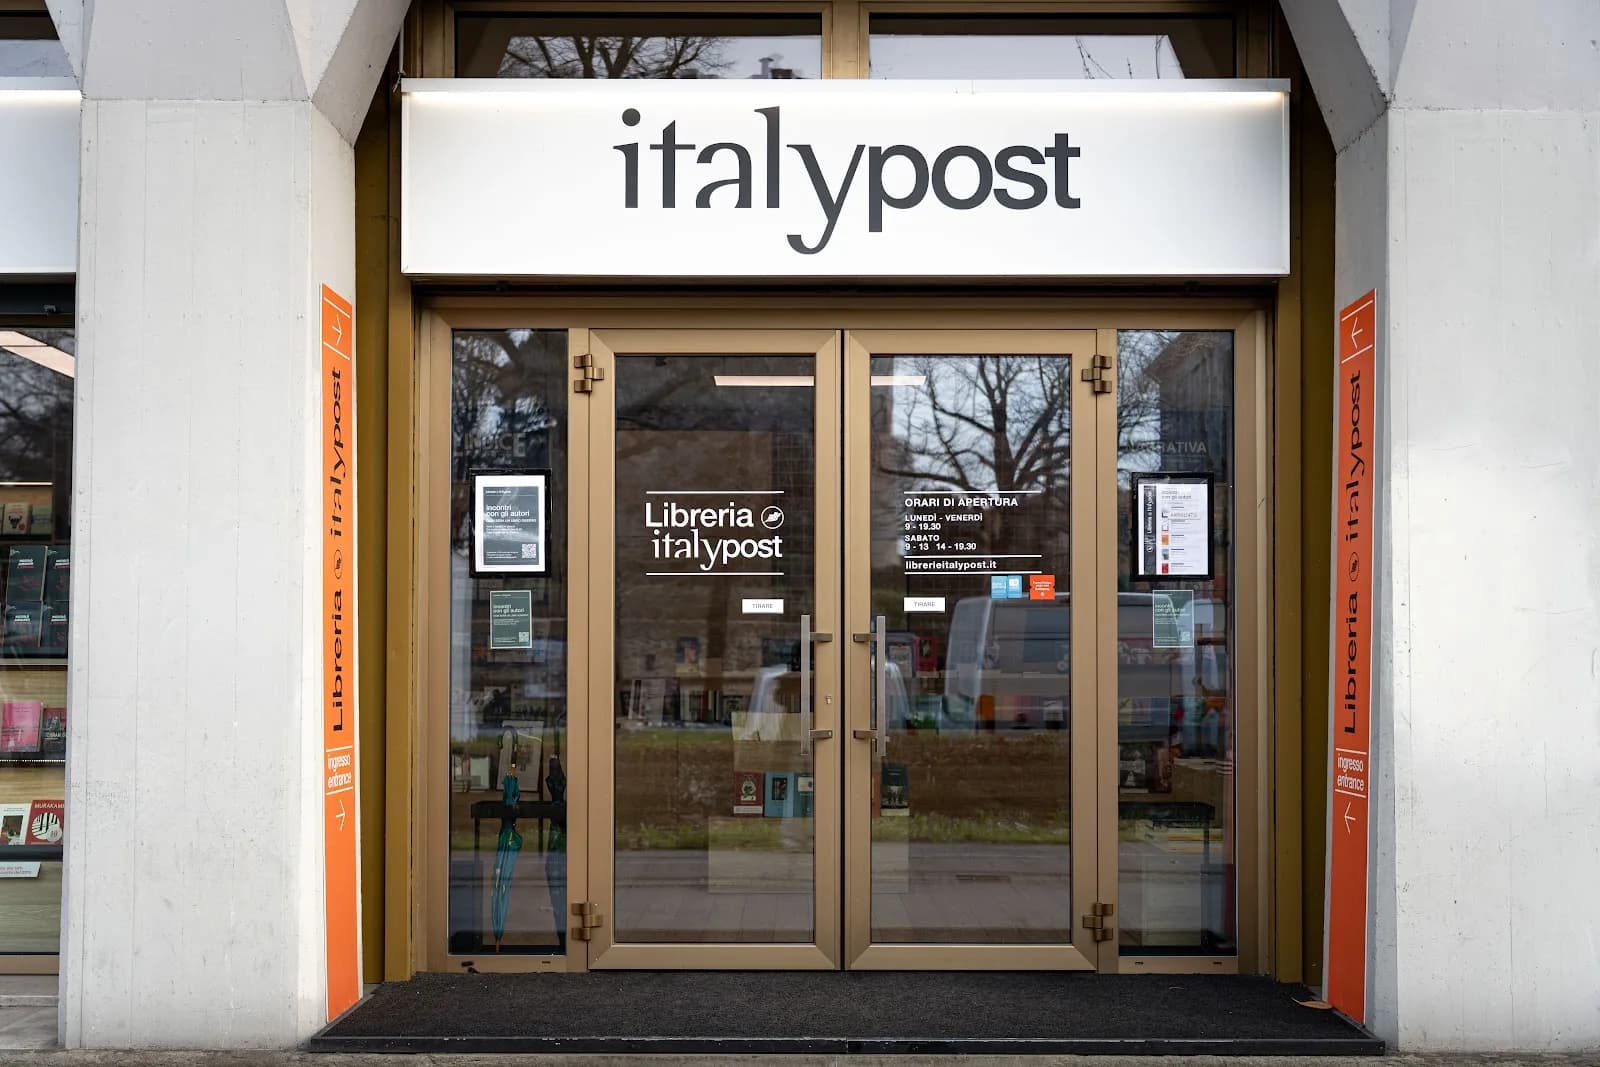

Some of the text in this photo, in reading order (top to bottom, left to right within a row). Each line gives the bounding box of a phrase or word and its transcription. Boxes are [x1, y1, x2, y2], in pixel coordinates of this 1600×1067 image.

[613, 106, 1080, 255] italypost
[330, 367, 346, 540] italypost
[1346, 370, 1364, 542] italypost
[905, 498, 1018, 507] ORARI DI APERTURA
[646, 502, 754, 527] Libreria
[905, 513, 936, 521] LUNEDÌ
[945, 513, 982, 521] VENERDÌ
[651, 528, 782, 570] italypost
[905, 561, 997, 570] librerieitalypost.it
[332, 588, 343, 732] Libreria
[1344, 592, 1358, 734] Libreria
[328, 754, 350, 772] ingresso
[1338, 753, 1363, 772] ingresso
[328, 772, 351, 788] entrance
[1337, 774, 1364, 791] entrance
